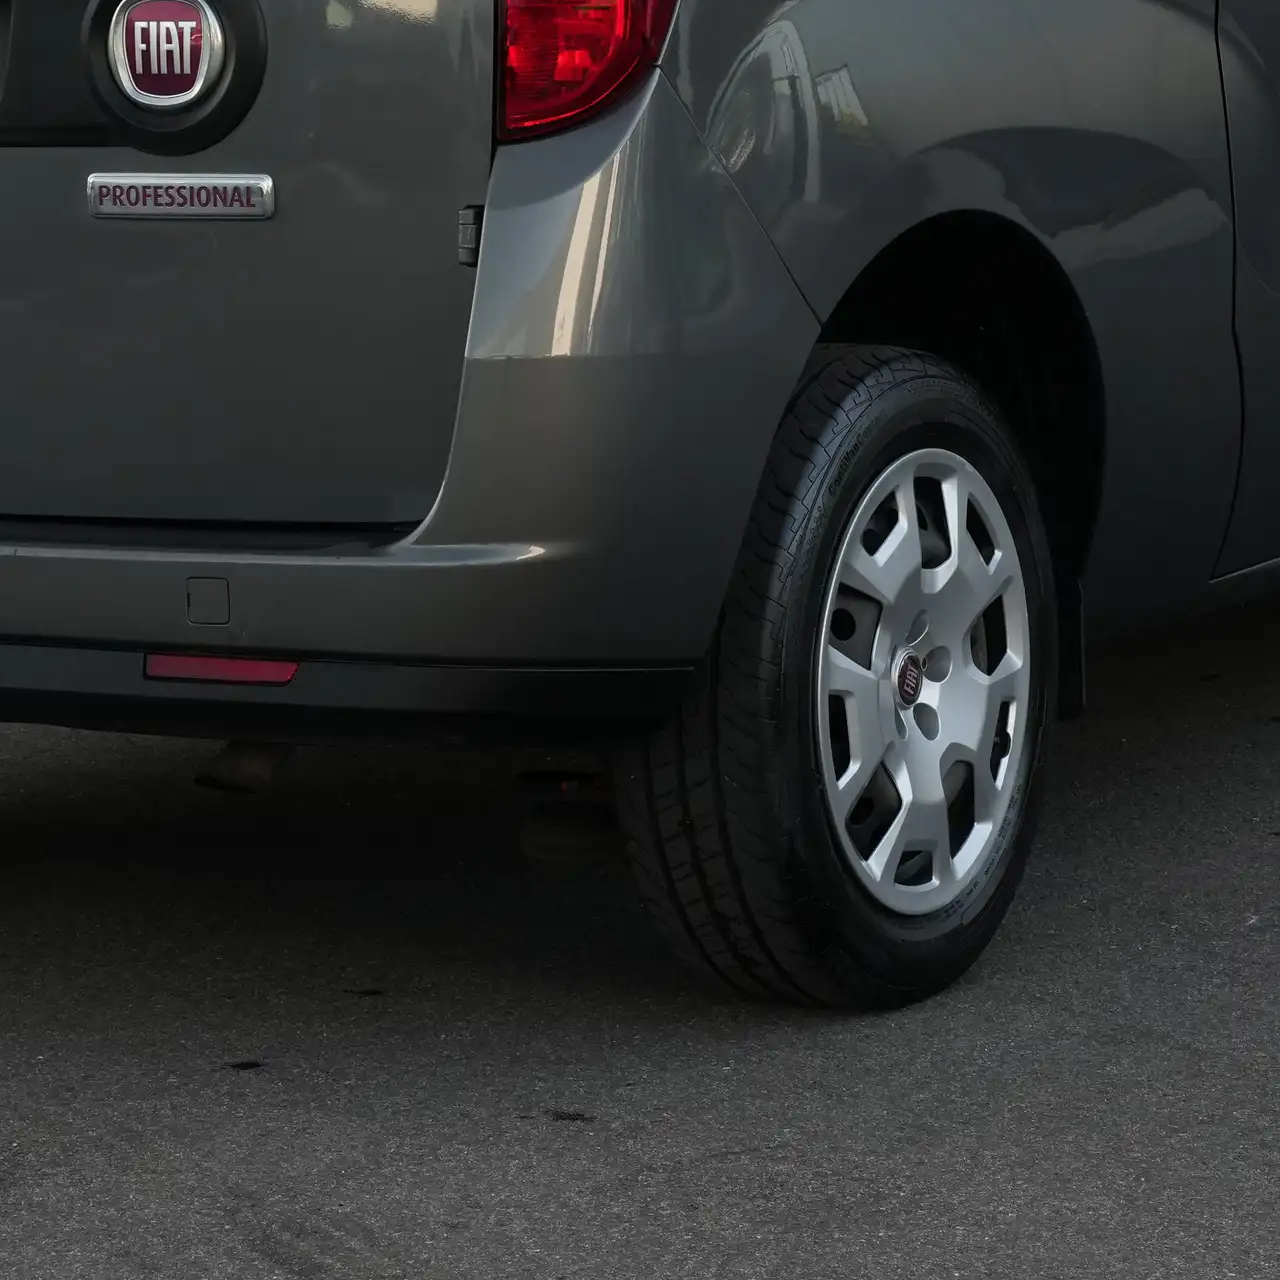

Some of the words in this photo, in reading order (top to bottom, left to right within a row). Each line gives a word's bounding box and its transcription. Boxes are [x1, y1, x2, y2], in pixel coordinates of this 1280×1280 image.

[134, 21, 196, 74] FIAT
[98, 185, 256, 208] PROFESSIONAL
[903, 663, 919, 695] FIAT
